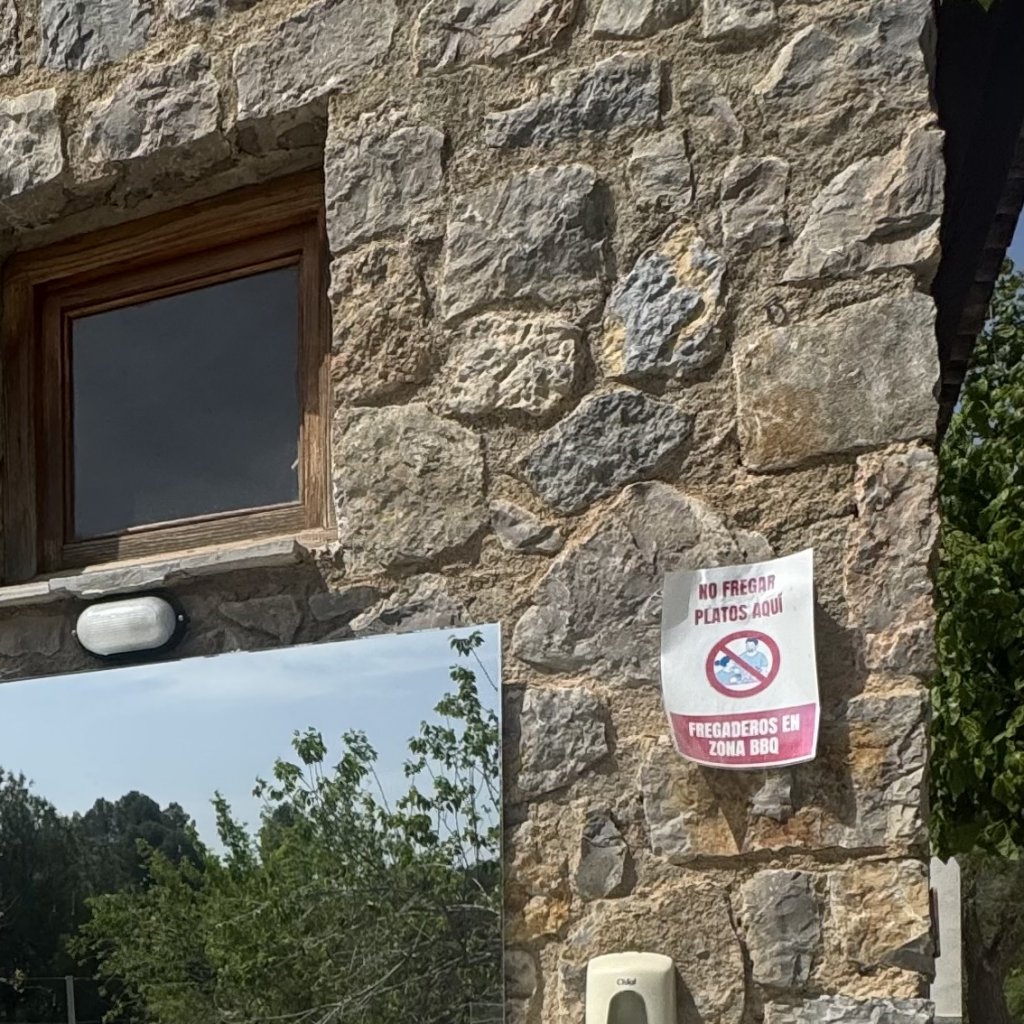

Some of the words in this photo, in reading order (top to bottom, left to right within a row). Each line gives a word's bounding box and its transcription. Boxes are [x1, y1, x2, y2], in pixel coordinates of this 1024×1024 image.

[698, 581, 718, 600] NO
[722, 574, 776, 598] FREGAR
[694, 604, 748, 625] PLATOS
[752, 592, 783, 619] AQUÍ
[688, 717, 778, 738] FREGADEROS
[782, 714, 800, 732] EN
[708, 739, 746, 757] ZONA
[750, 737, 779, 756] BBQ
